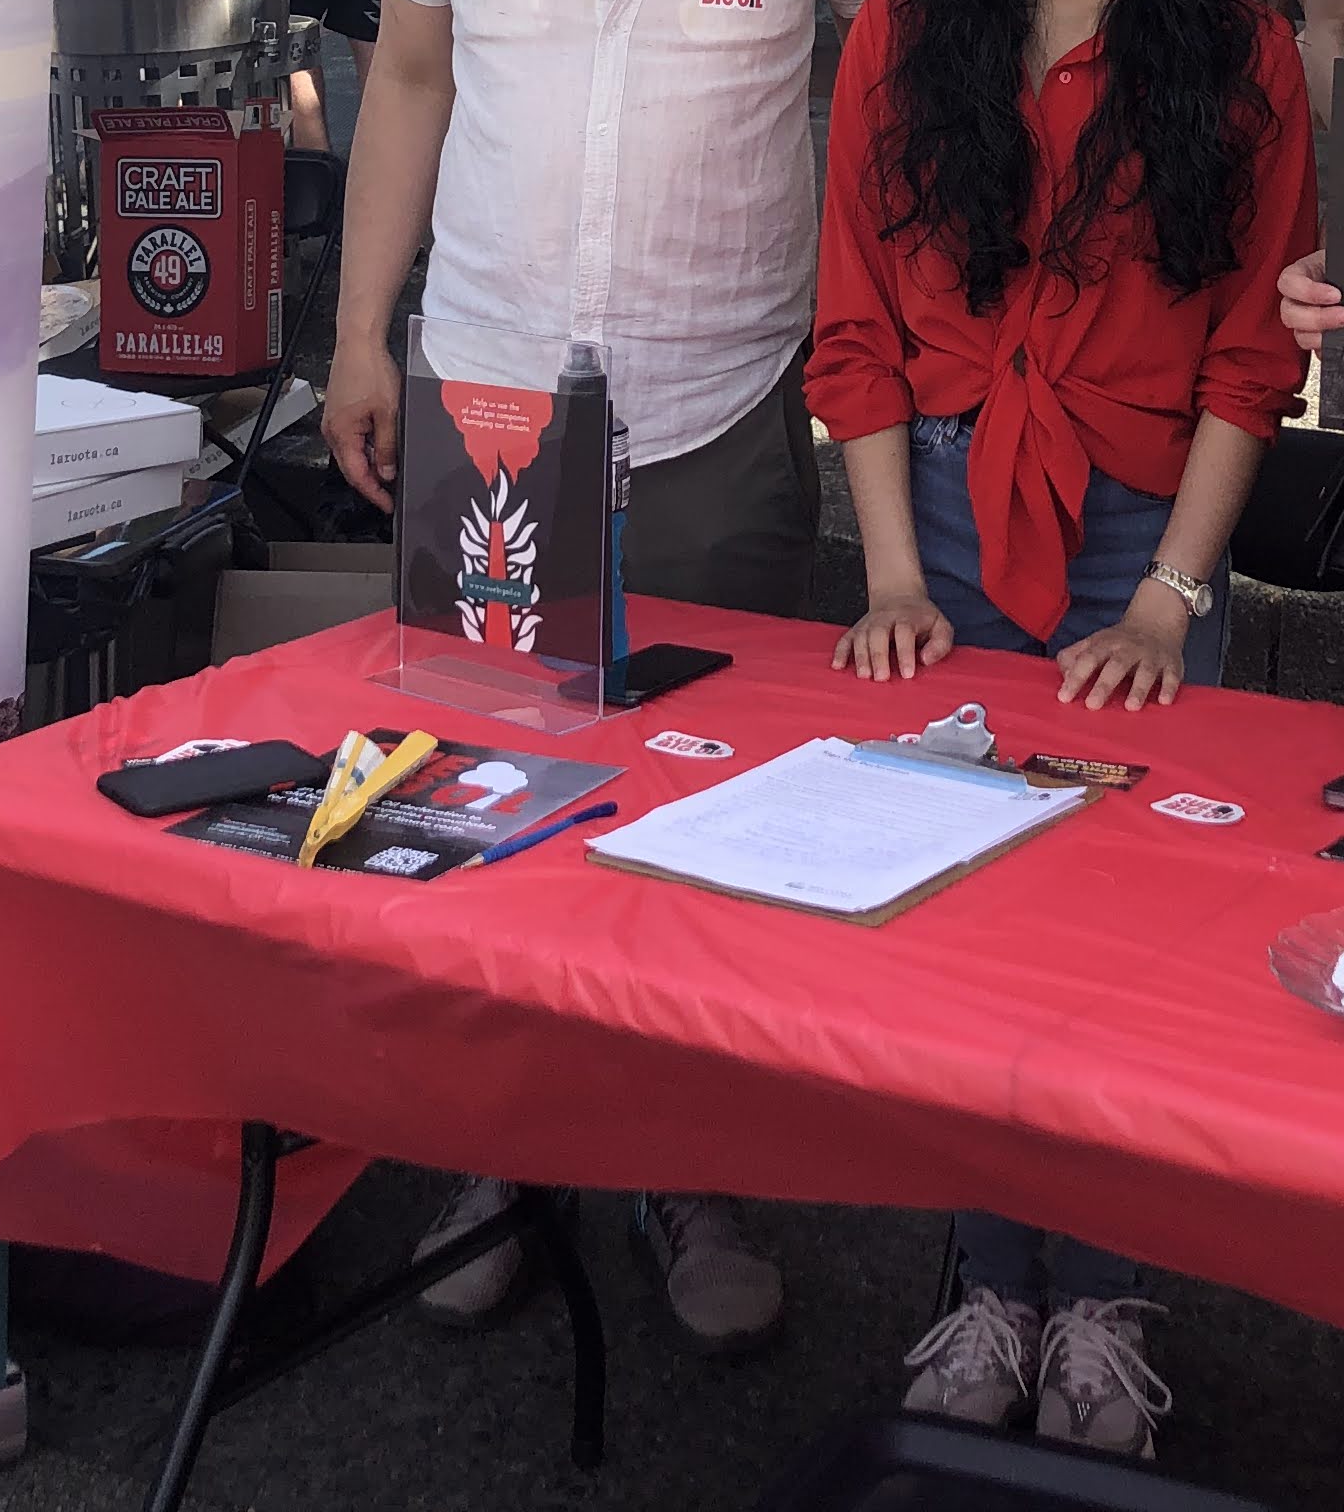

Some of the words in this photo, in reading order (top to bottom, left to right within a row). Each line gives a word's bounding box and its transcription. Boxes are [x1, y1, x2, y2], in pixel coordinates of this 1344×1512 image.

[106, 117, 135, 129] ALE
[137, 116, 172, 128] PALE
[177, 117, 221, 128] CRAFT
[125, 166, 213, 190] CRAFT
[125, 191, 171, 209] PALE
[175, 192, 213, 210] ALE
[136, 232, 203, 268] PARALLEL
[154, 255, 182, 285] 49
[116, 333, 223, 355] PARALLEL49
[50, 446, 119, 465] laruota.ca
